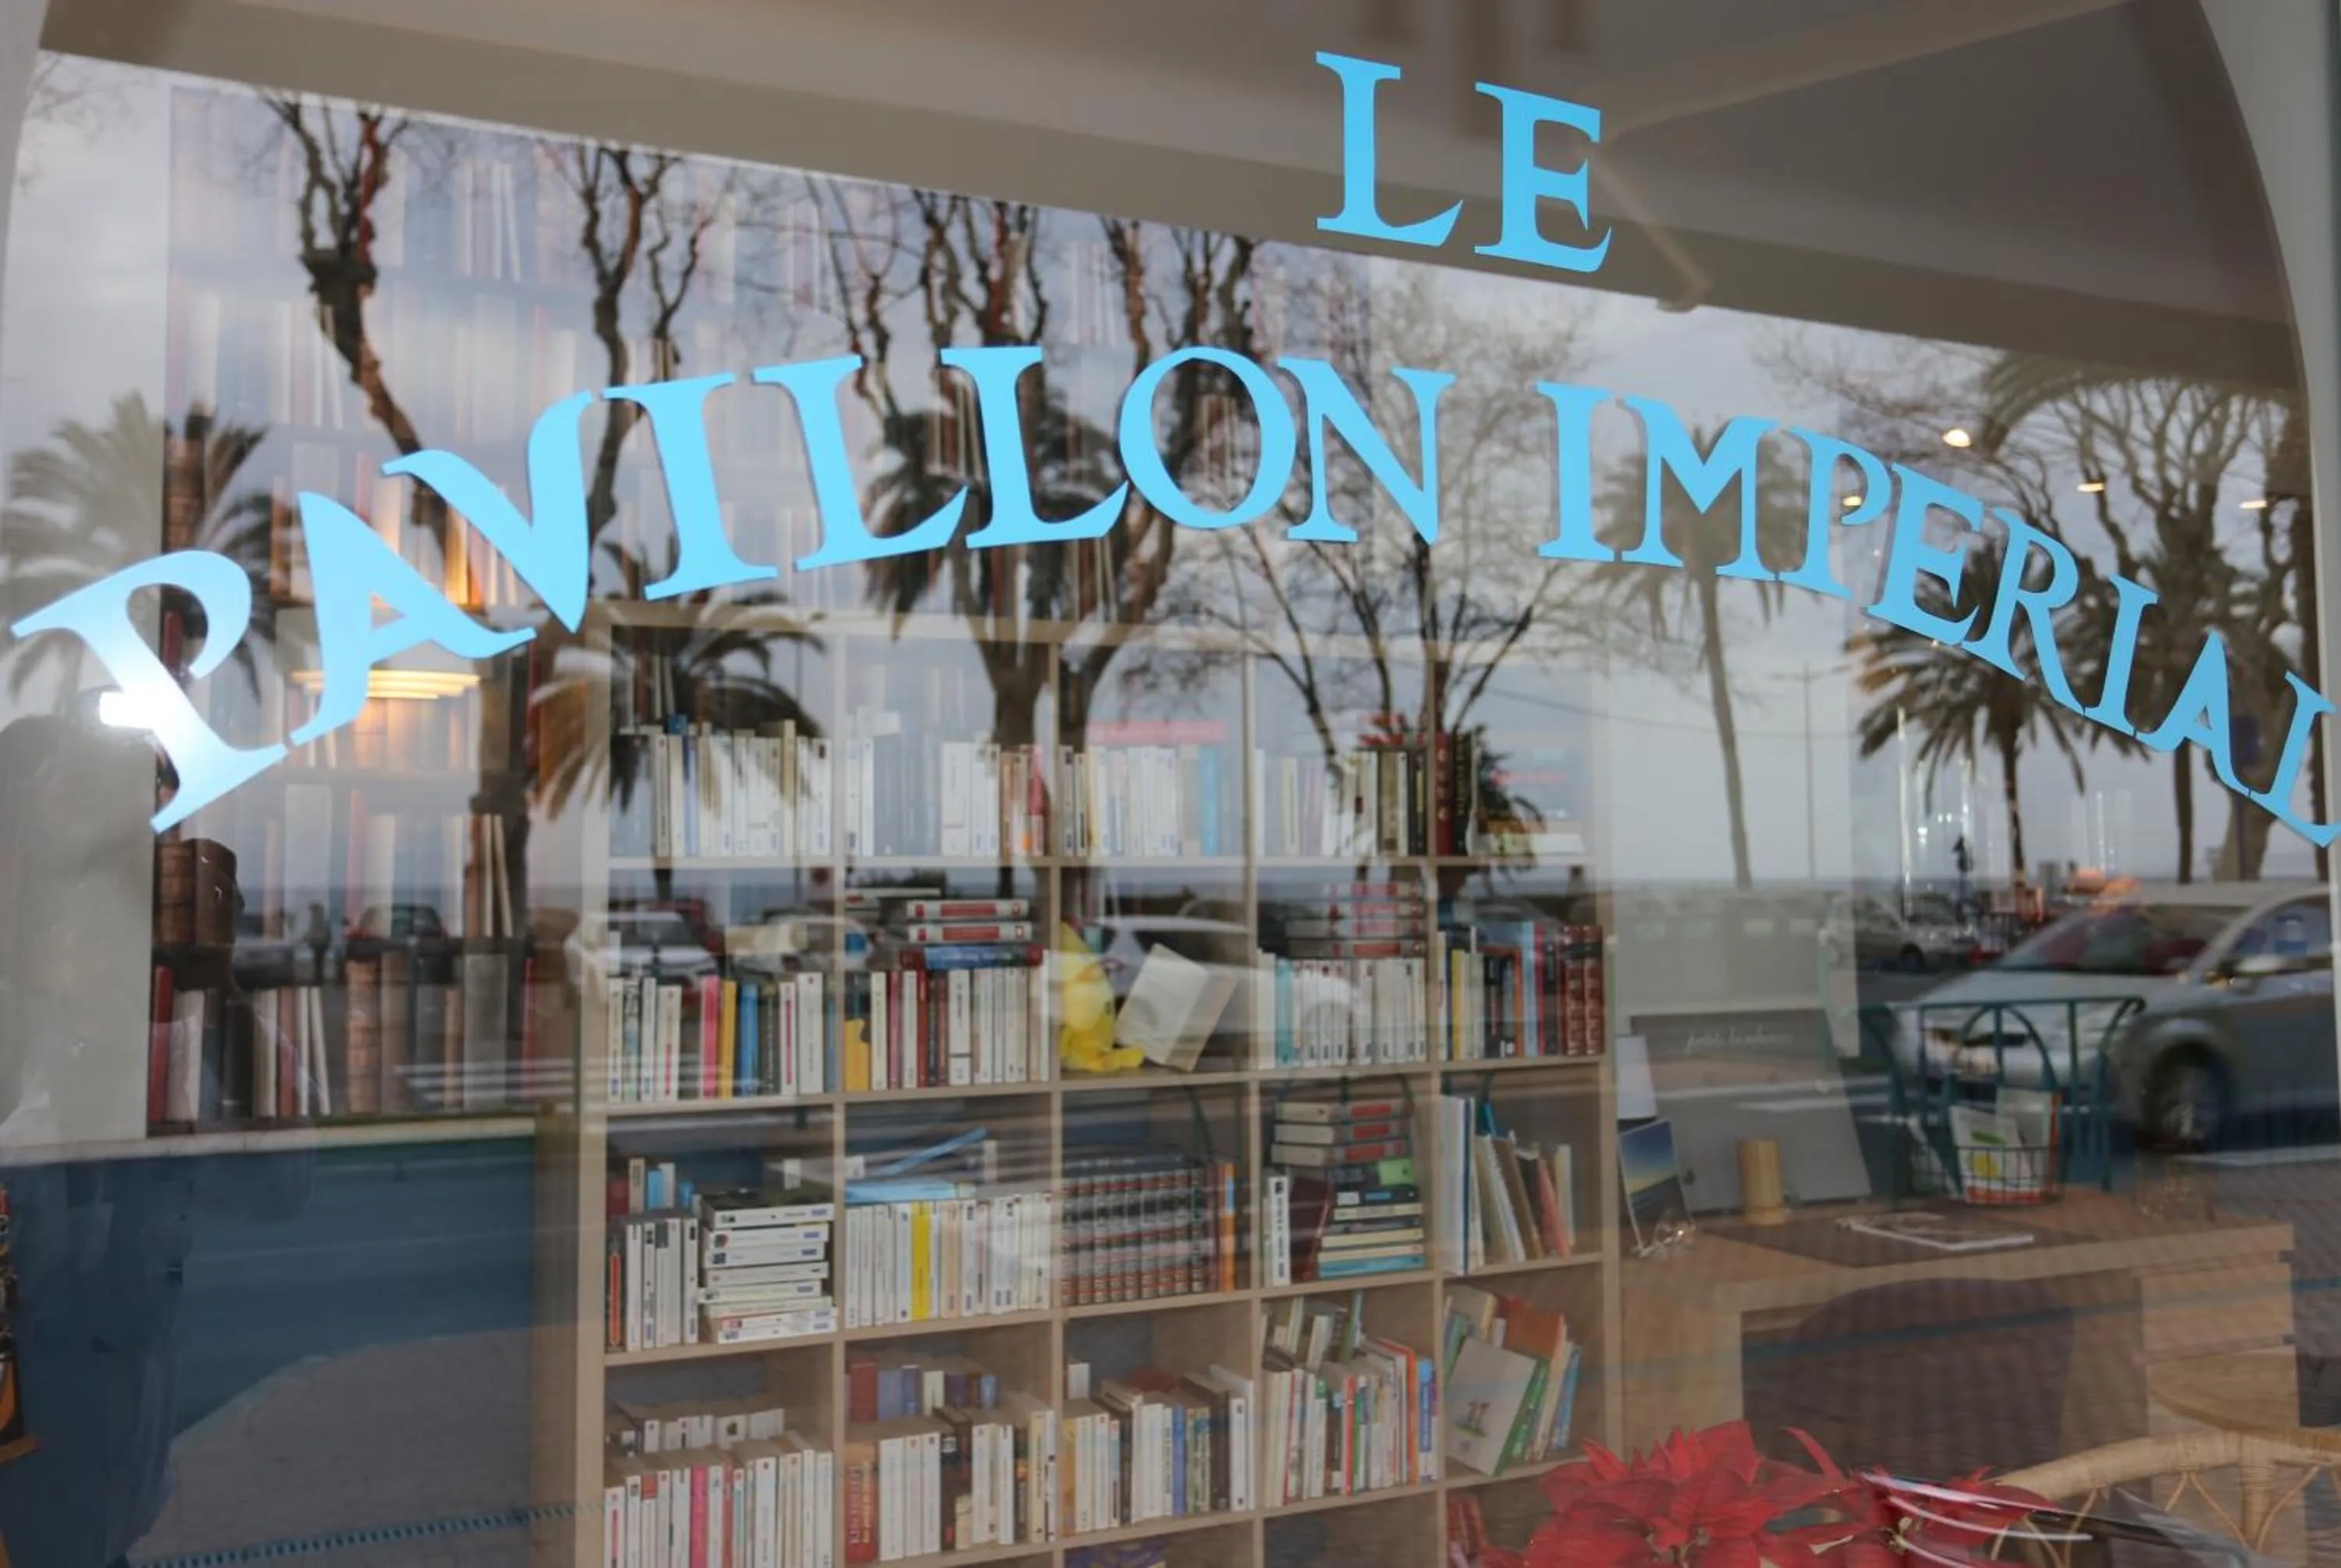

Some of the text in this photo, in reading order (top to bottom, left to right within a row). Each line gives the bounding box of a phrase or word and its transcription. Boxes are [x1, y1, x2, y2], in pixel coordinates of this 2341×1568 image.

[1315, 51, 1612, 273] LE
[10, 344, 2341, 848] PAVILLON IMPERIAL
